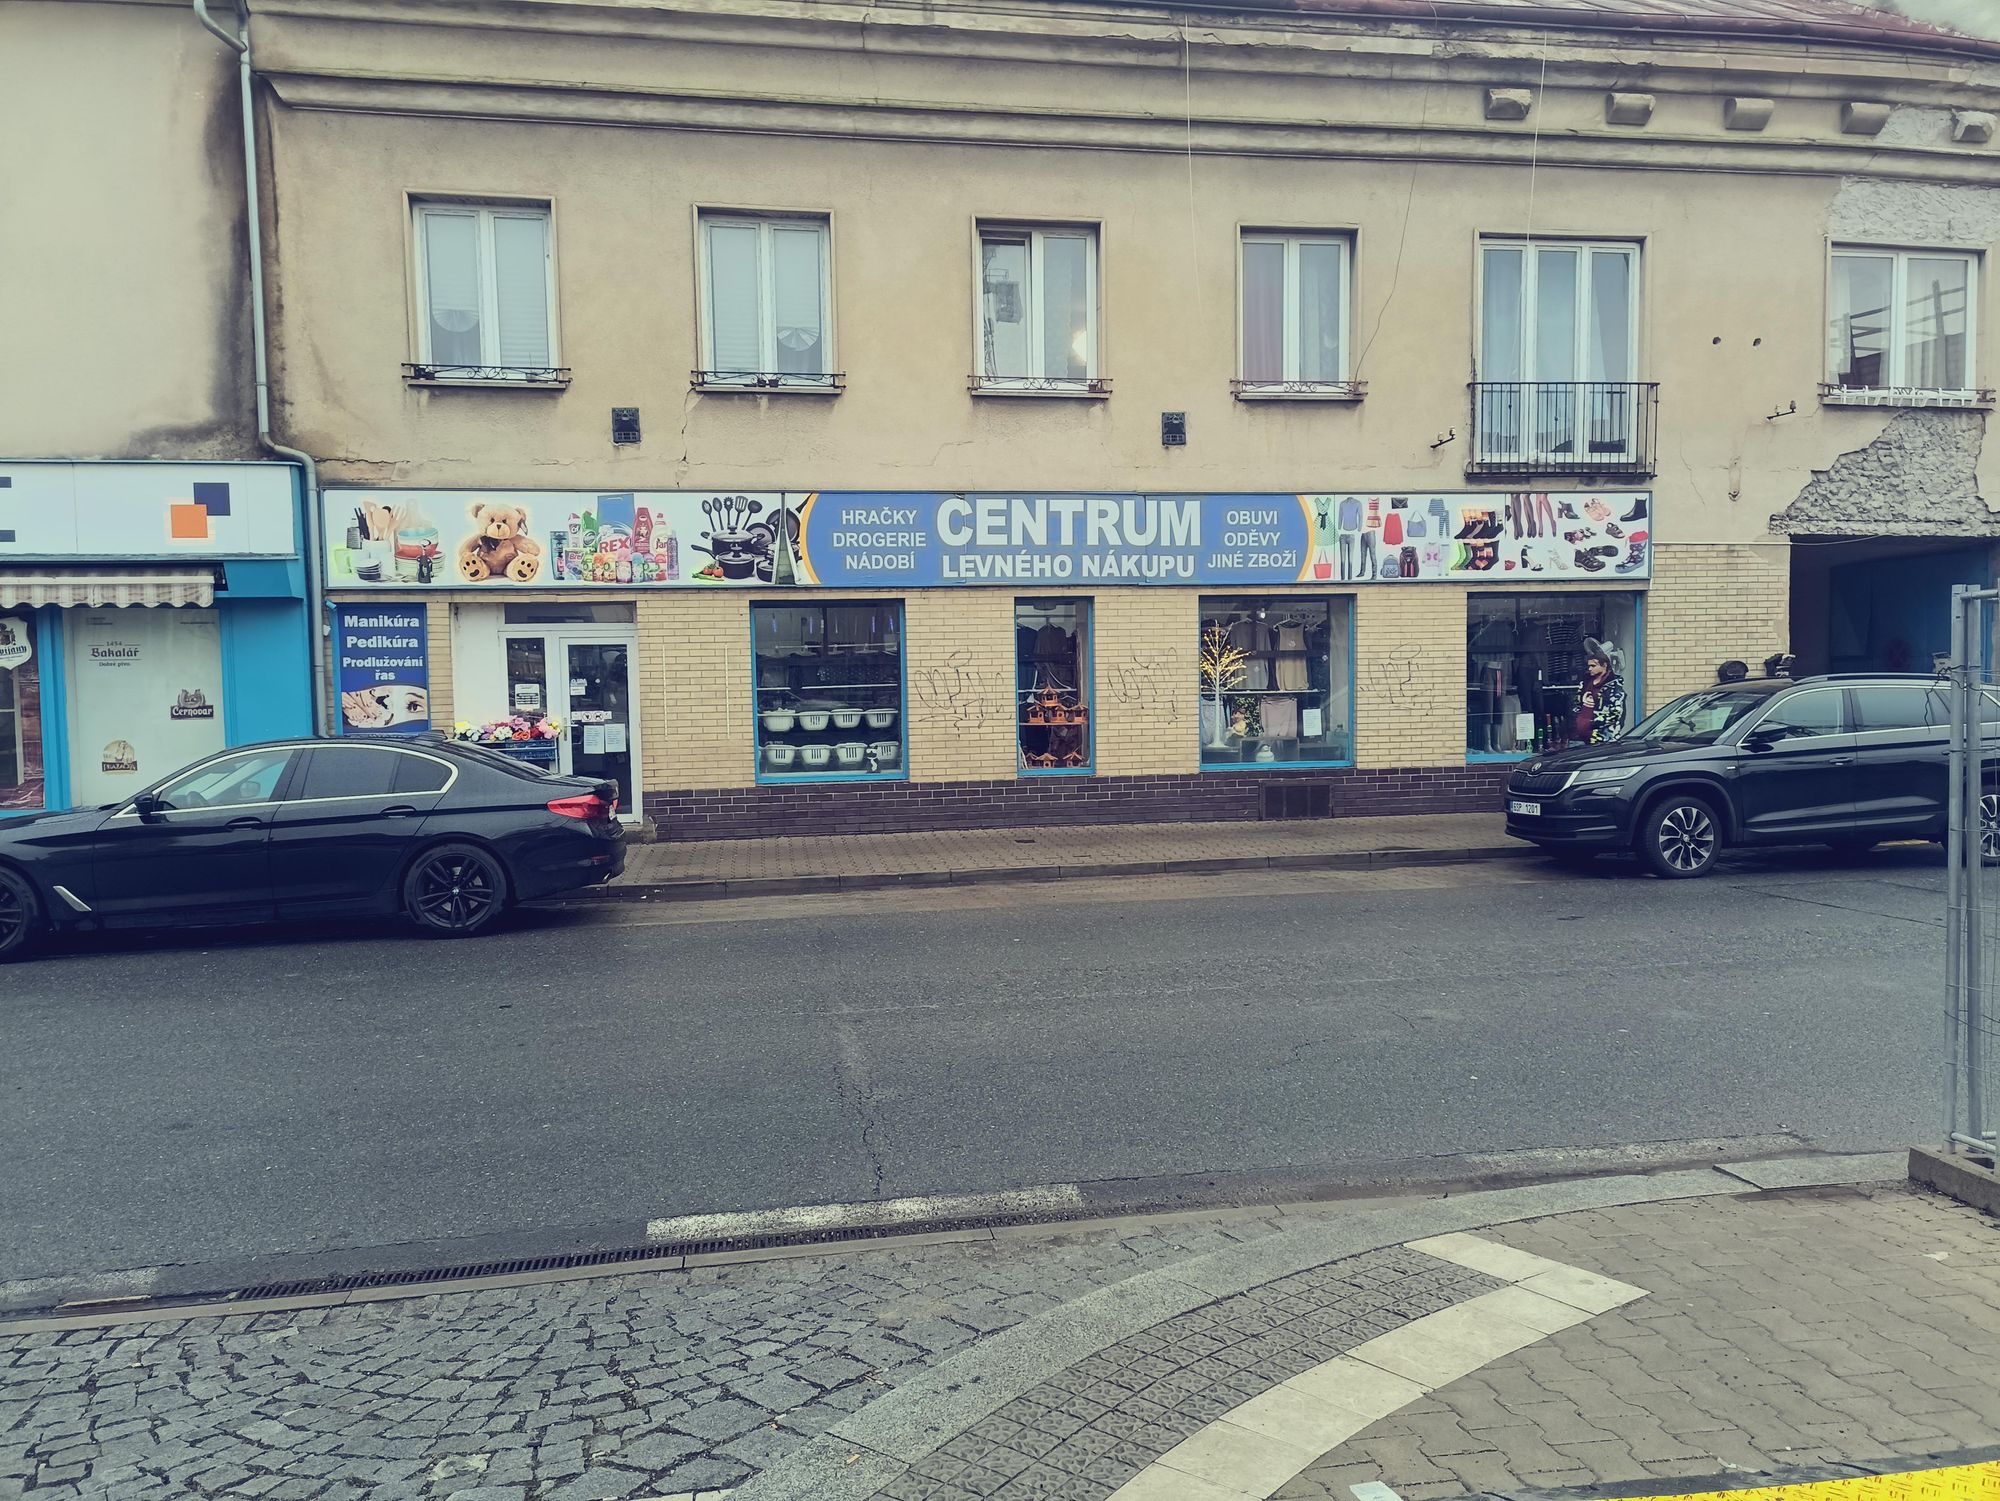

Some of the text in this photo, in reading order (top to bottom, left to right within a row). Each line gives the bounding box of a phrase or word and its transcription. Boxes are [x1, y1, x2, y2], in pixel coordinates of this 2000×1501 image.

[842, 506, 917, 525] HRAČKY
[936, 499, 1201, 547] CENTRUM
[1226, 510, 1278, 525] OBUVI
[599, 536, 630, 553] REX
[833, 532, 927, 547] DROGERIE
[1224, 529, 1281, 546] ODĚVY
[846, 551, 915, 569] NÁDOBÍ
[942, 550, 1195, 578] LEVNÉHO NÁKUPU
[1207, 550, 1297, 568] JINÉ ZBOŽÍ
[344, 614, 420, 628] Manikúra
[346, 635, 419, 648] Pedikúra
[91, 647, 140, 658] Bakalář
[342, 655, 424, 668] Prodlužování
[375, 669, 396, 681] řas
